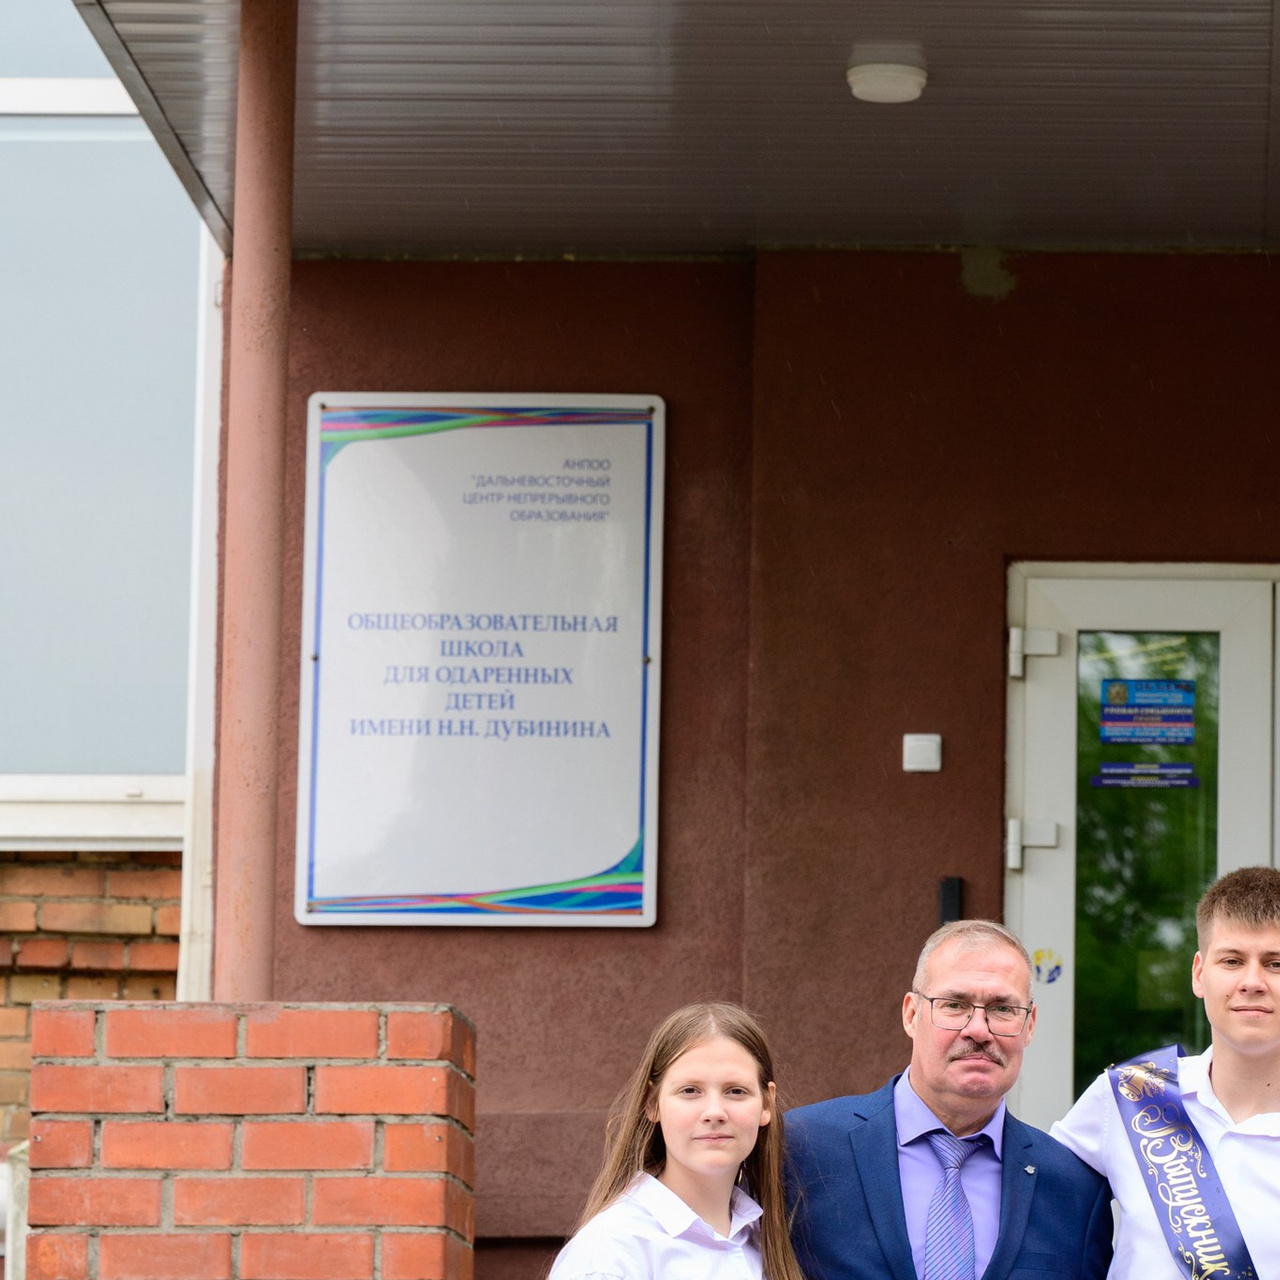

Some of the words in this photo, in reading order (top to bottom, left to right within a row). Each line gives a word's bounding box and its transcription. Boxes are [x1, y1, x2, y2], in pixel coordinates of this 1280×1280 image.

[563, 458, 612, 471] АНПОО
[462, 492, 505, 506] ЦЕНТР
[507, 492, 611, 506] НЕПРЕРЫВНОГО
[347, 612, 619, 634] ОБЩЕОБРАЗОВАТЕЛЬНАЯ
[440, 639, 525, 658] ШКОЛА
[383, 665, 431, 686] ДЛЯ
[435, 666, 574, 688] ОДАРЕННЫХ
[444, 689, 516, 712] ДЕТЕЙ
[350, 718, 432, 737] ИМЕНИ
[437, 718, 480, 737] Н.Н.
[483, 719, 611, 741] ДУБИНИНА
